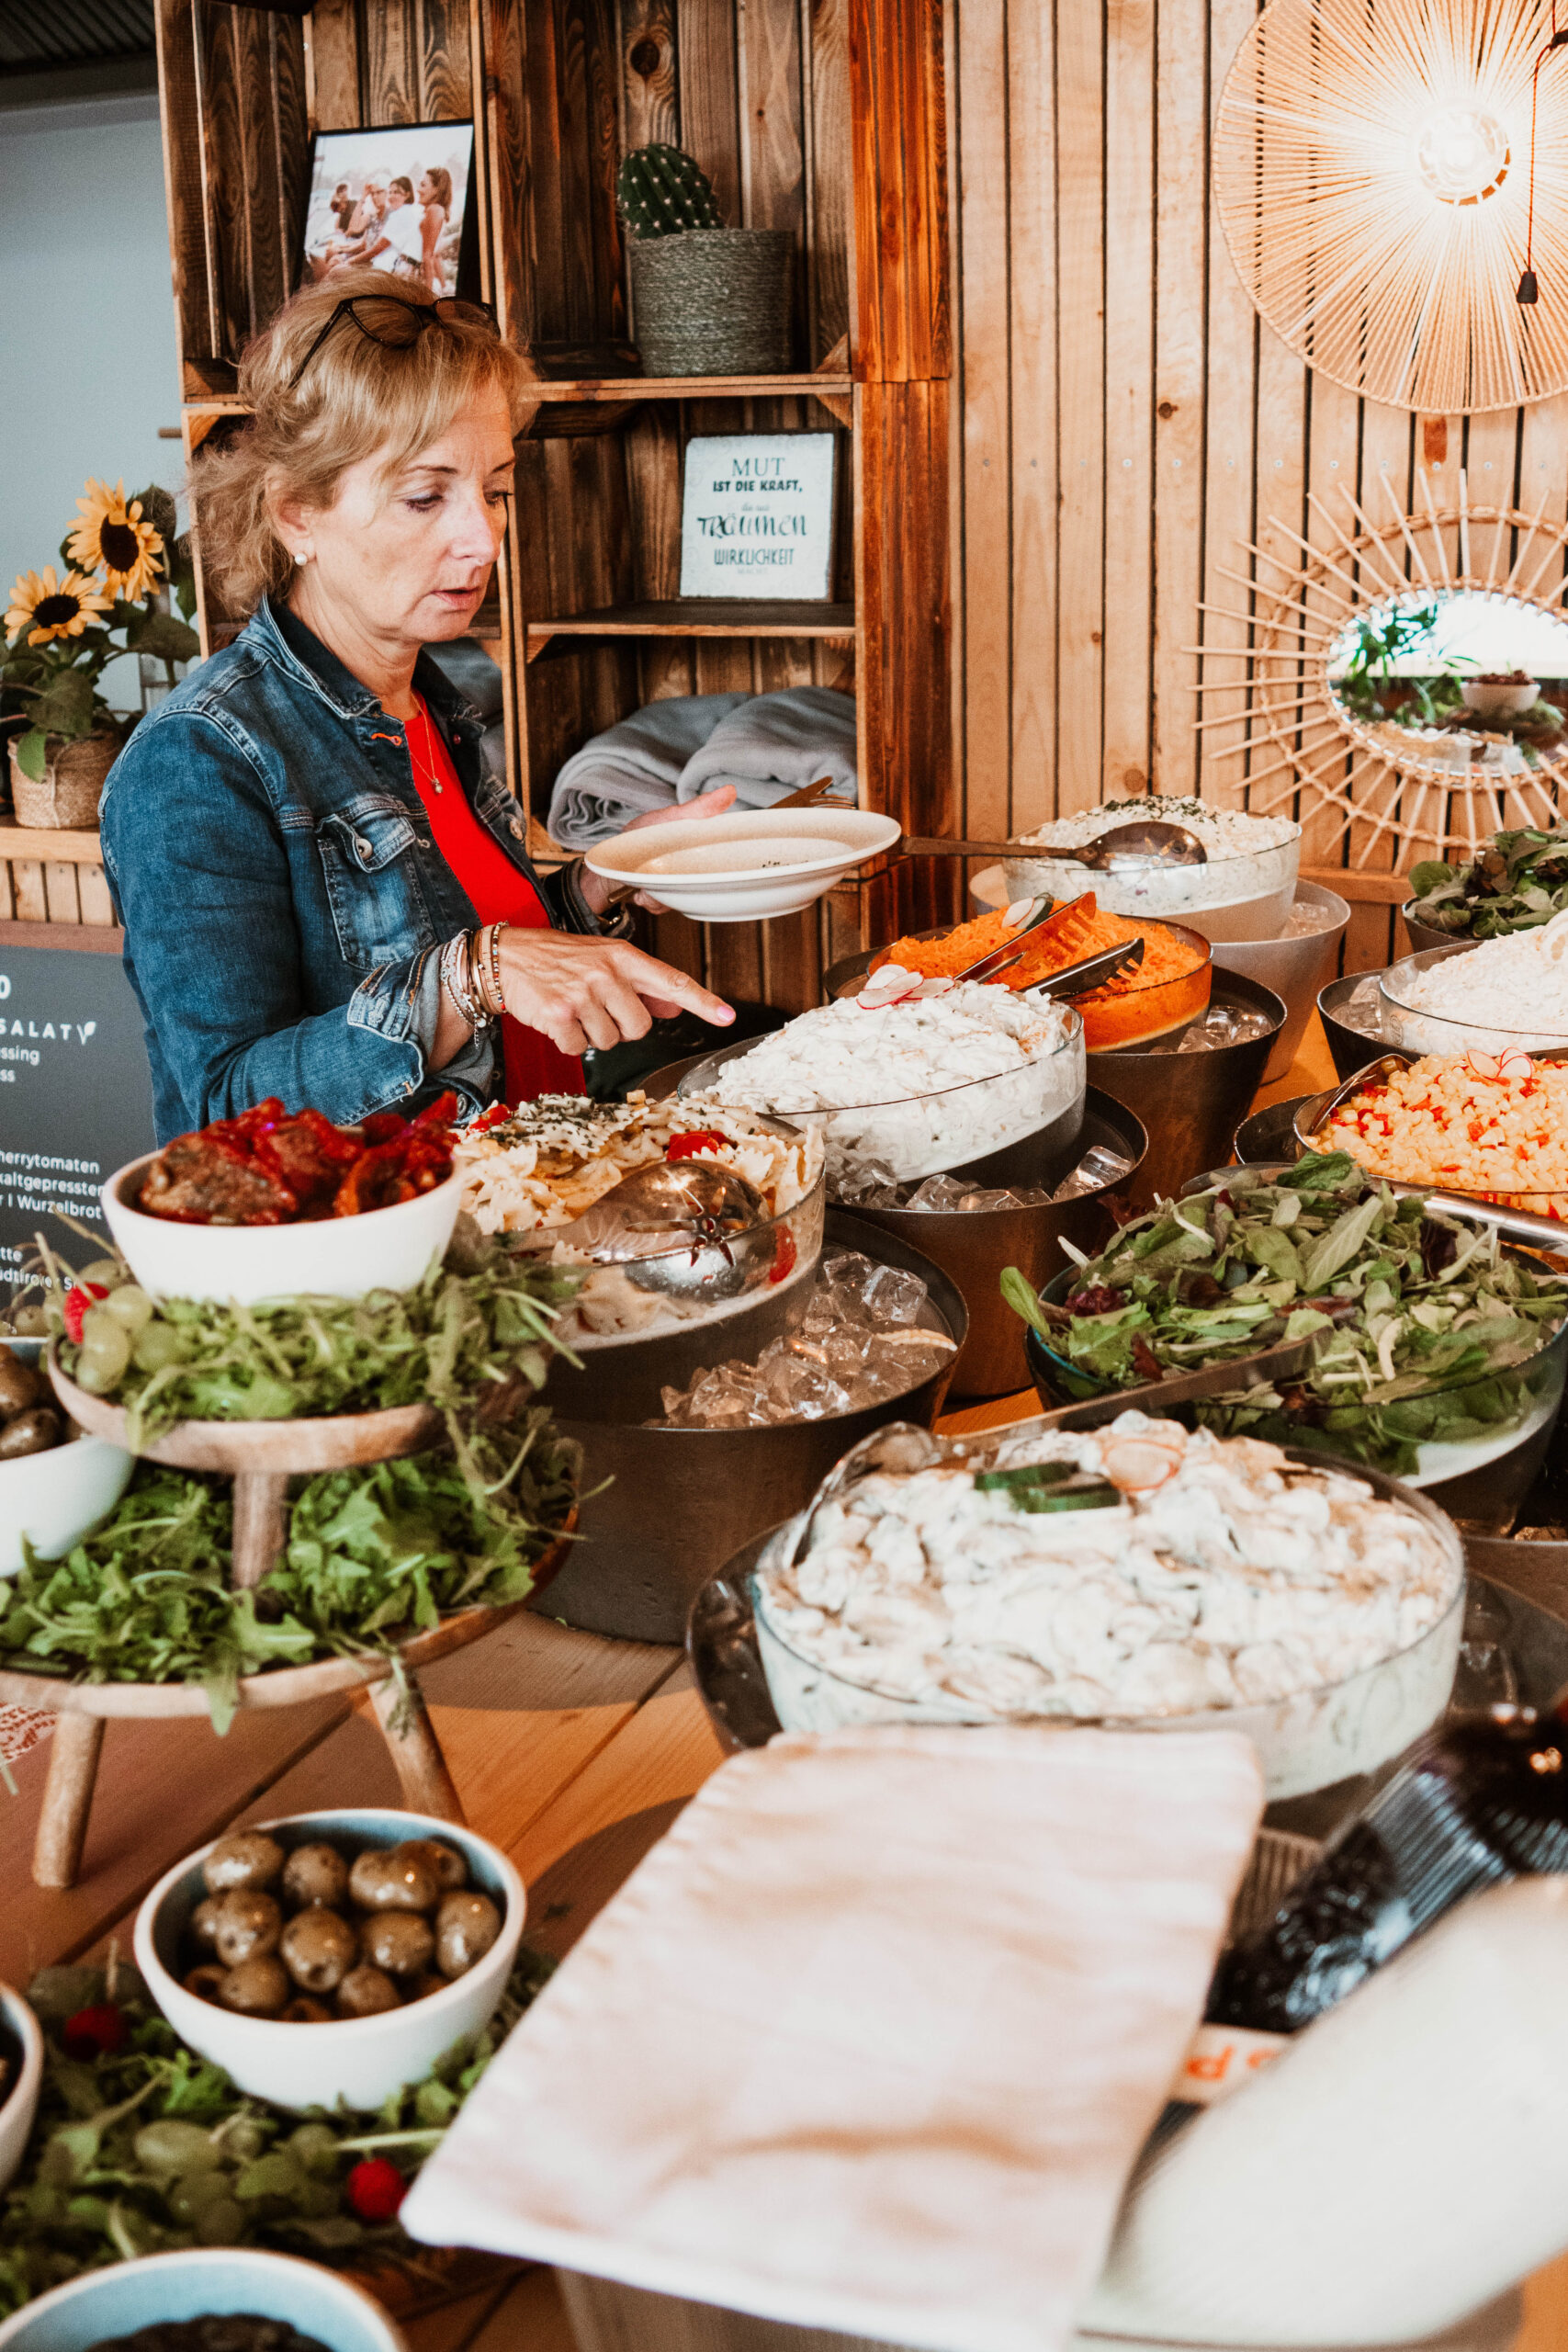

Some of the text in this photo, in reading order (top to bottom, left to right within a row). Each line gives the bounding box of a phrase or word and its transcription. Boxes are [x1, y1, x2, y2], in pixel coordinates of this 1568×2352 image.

[732, 458, 785, 476] MUT
[713, 480, 803, 493] IST DIE KRAFT,
[713, 548, 795, 565] WIRKLICHKEIT
[17, 1194, 102, 1220] Wurzelbrot
